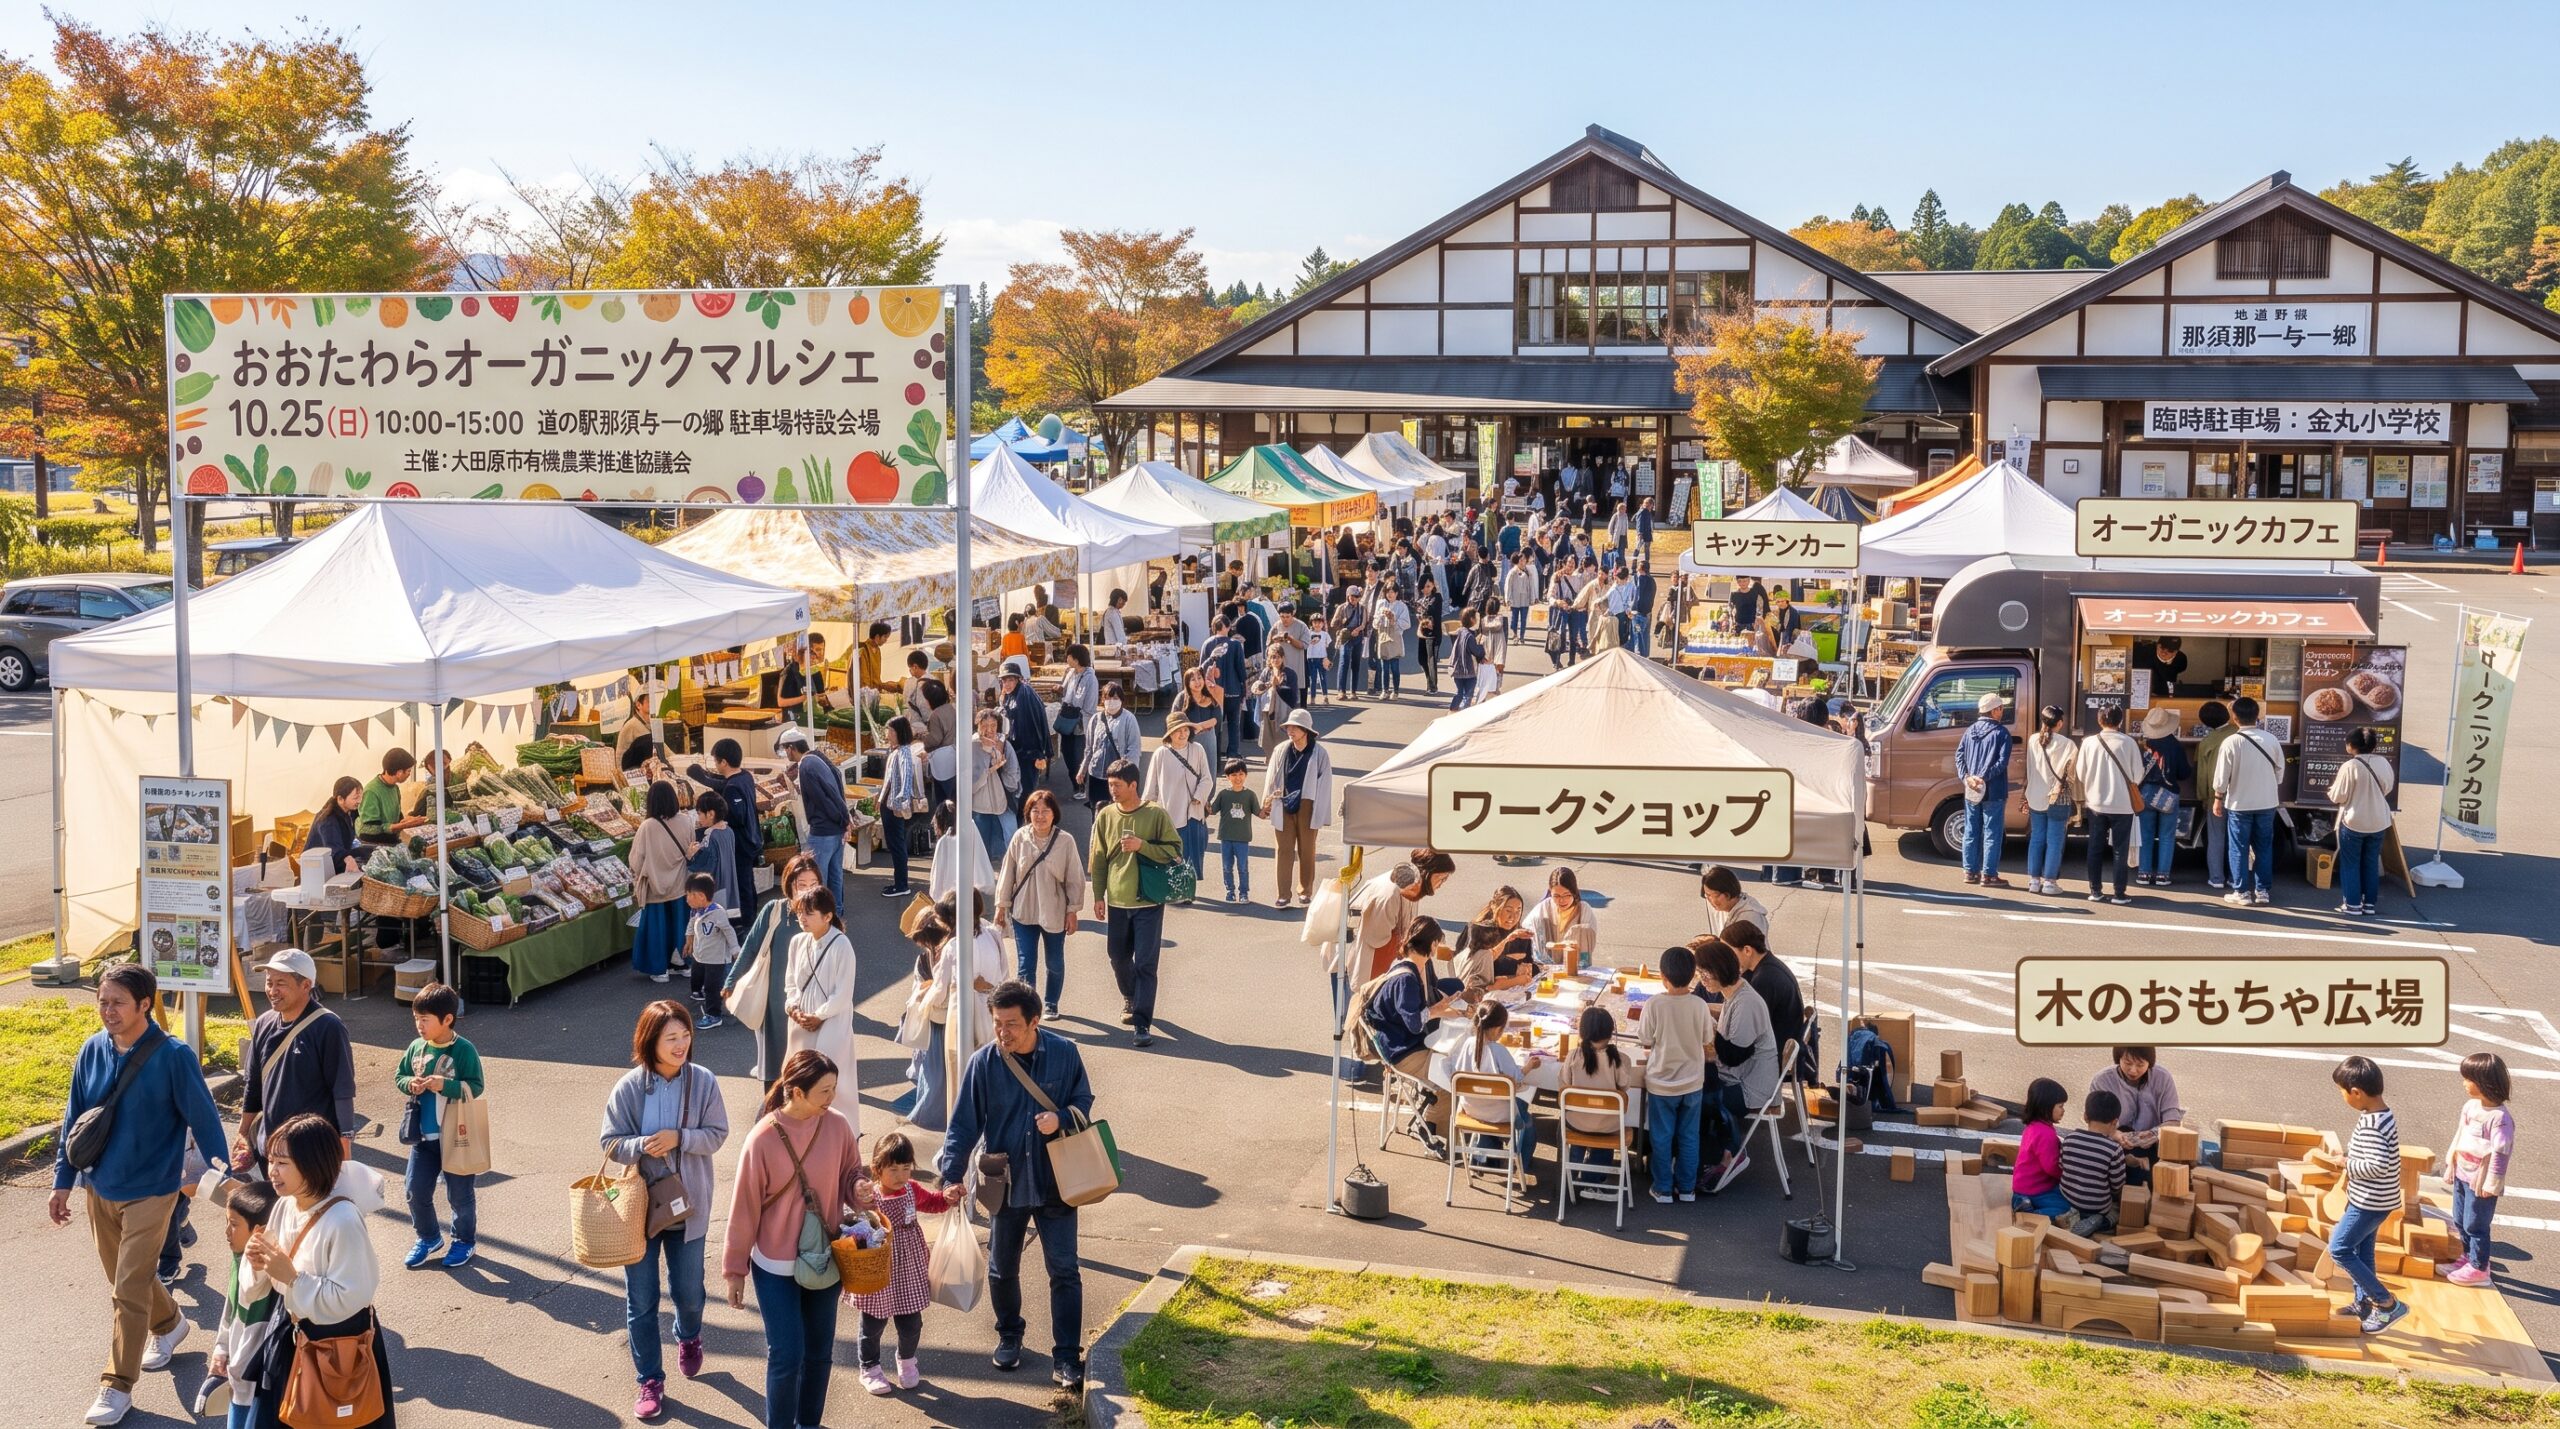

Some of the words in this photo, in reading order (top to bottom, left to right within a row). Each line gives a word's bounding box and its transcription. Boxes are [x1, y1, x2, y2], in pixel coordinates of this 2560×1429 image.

[232, 335, 879, 389] おおたわらオーガニックマルシェ
[375, 409, 524, 435] 10:00-15:00
[538, 408, 725, 436] 道の駅那須与一の郷
[729, 408, 881, 436] 駐車場特設会場
[2152, 407, 2441, 434] 臨時駐車場：金丸小学校
[403, 449, 692, 474] 主催：大田原市有機農業推進協議会
[2092, 513, 2340, 544] オーガニックカフェ
[1705, 532, 1846, 557] キッチンカー
[2103, 608, 2328, 626] オーガニックカフェ
[1452, 788, 1772, 838] ワークショップ
[2034, 977, 2424, 1028] 木のおもちゃ広場
